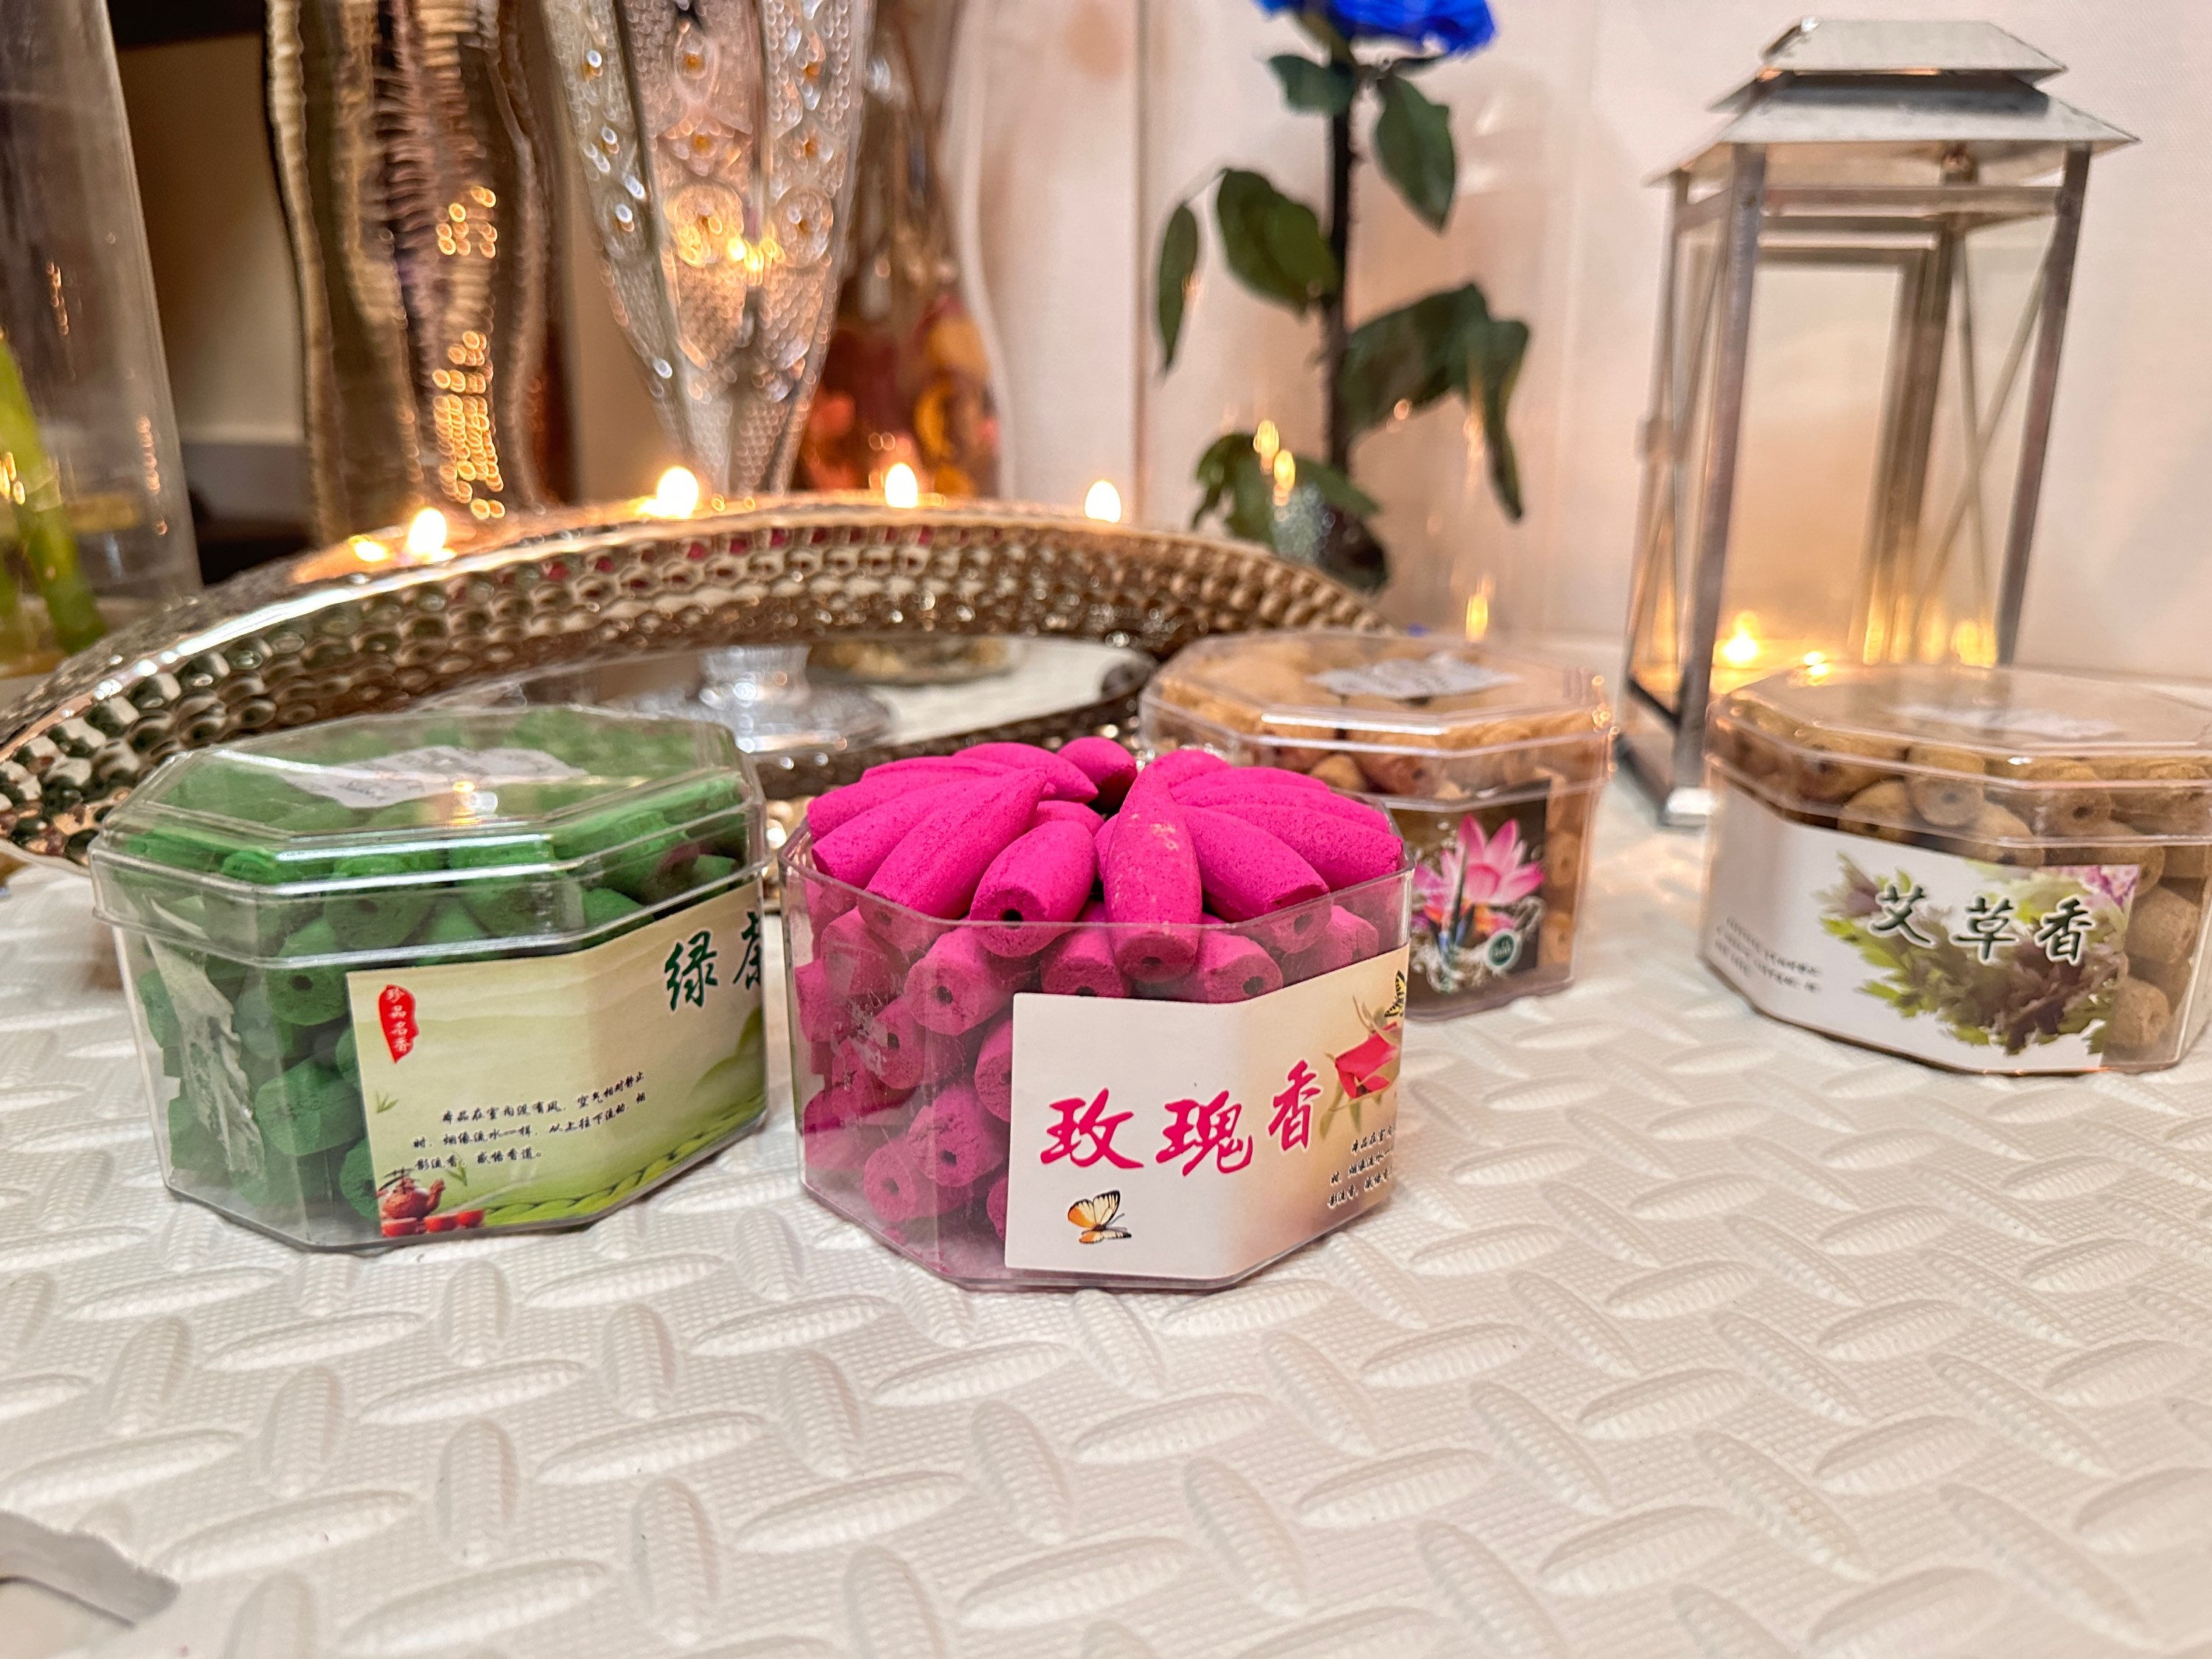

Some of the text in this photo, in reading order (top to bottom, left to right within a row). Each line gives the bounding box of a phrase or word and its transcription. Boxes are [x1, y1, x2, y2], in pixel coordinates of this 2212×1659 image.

[1873, 884, 2093, 964] 艾草香
[1040, 1058, 1320, 1177] 玫瑰香
